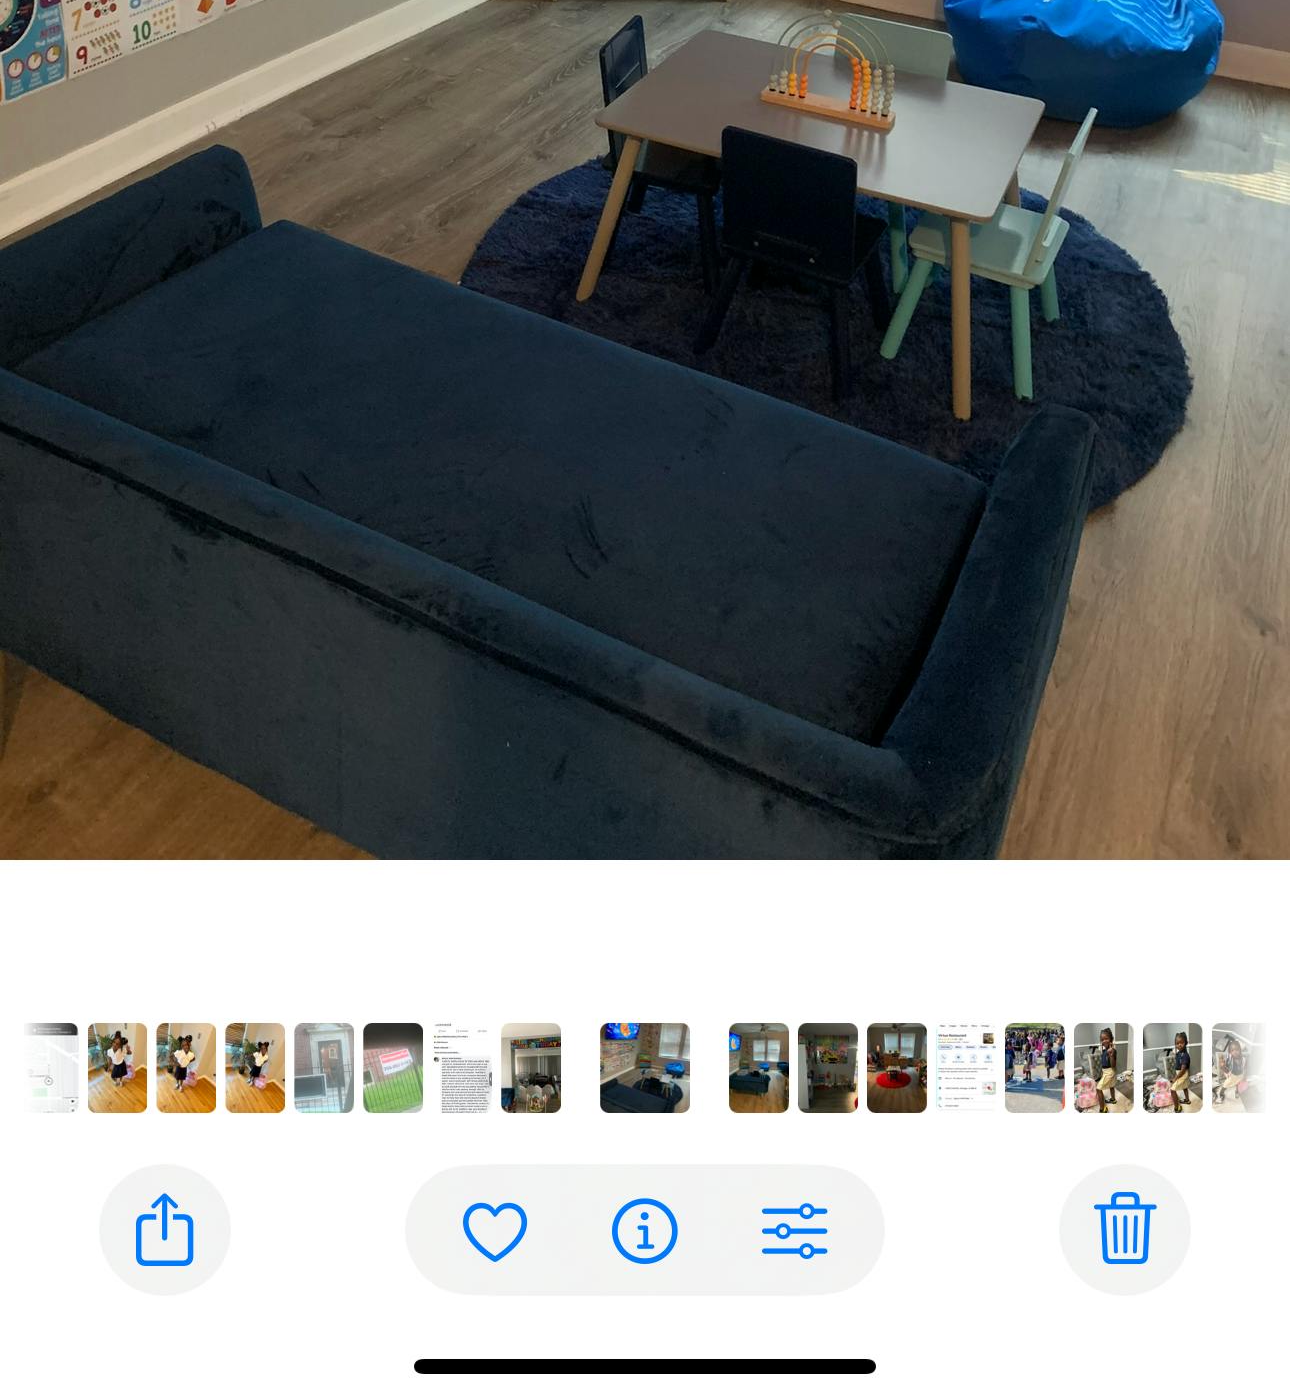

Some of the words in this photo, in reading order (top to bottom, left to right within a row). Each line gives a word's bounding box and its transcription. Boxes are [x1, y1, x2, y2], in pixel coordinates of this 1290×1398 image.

[72, 9, 82, 31] 7
[133, 20, 152, 44] 10
[76, 45, 88, 65] 9
